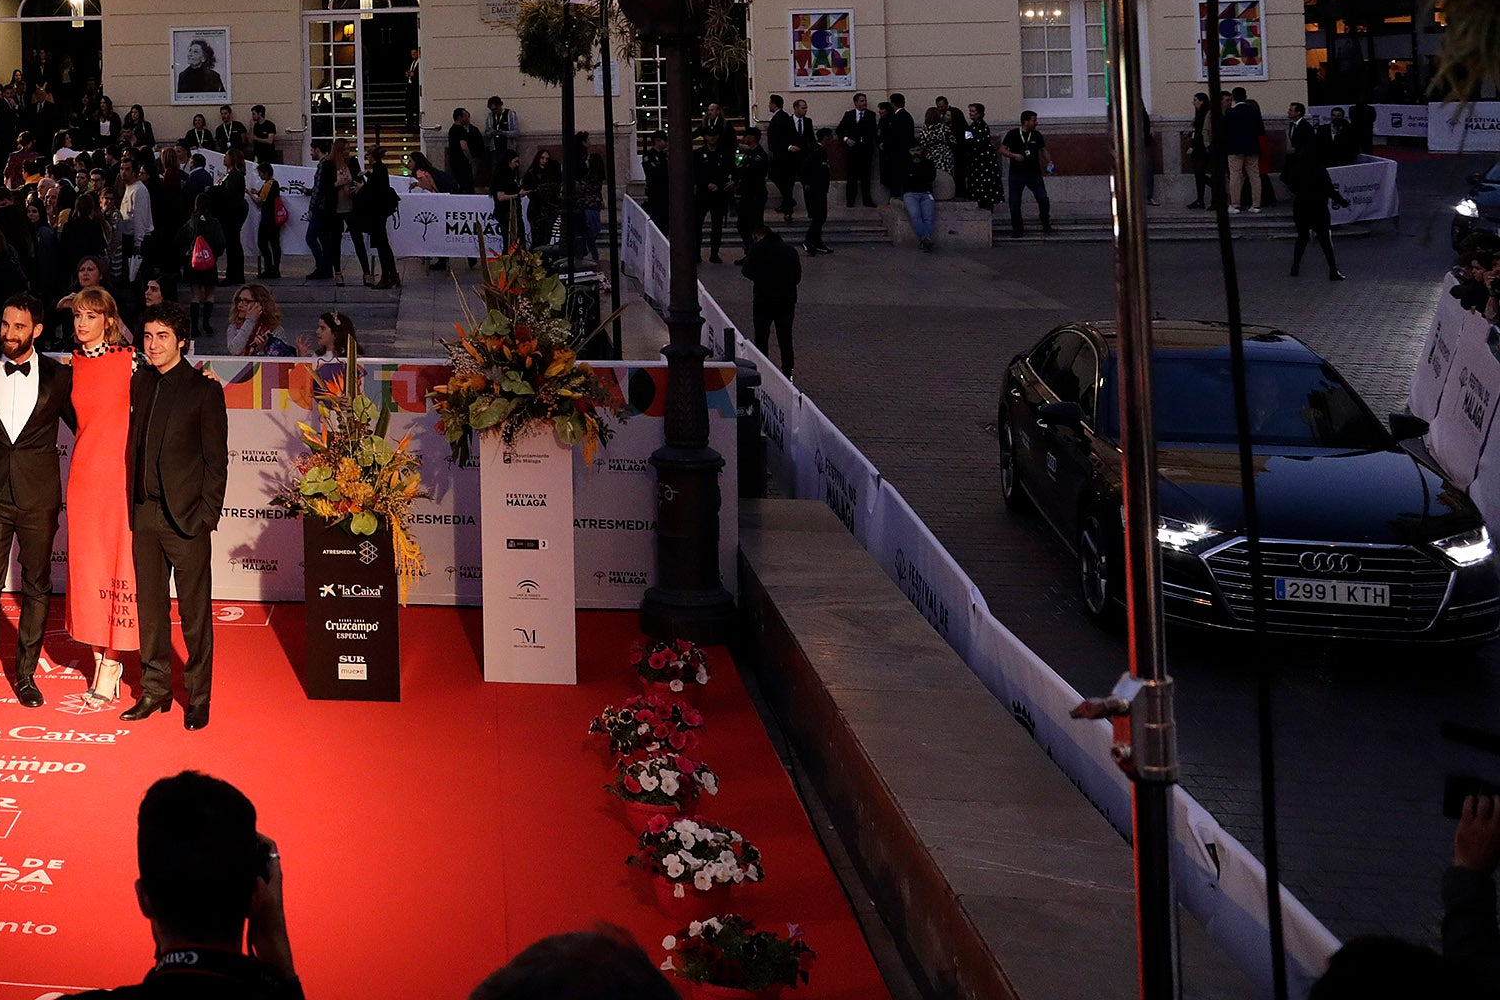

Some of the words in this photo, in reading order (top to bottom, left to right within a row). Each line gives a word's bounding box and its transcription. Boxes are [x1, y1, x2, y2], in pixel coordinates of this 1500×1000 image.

[445, 211, 494, 221] FESTIVA
[506, 498, 547, 507] MÁLAGA
[406, 515, 476, 525] RESMEDIA
[573, 519, 659, 531] ATRESMEDIA
[1289, 582, 1337, 601] 2991
[1347, 585, 1385, 604] KTH
[325, 620, 379, 633] Cruzcampo
[338, 655, 366, 663] SUR
[21, 857, 65, 870] DE
